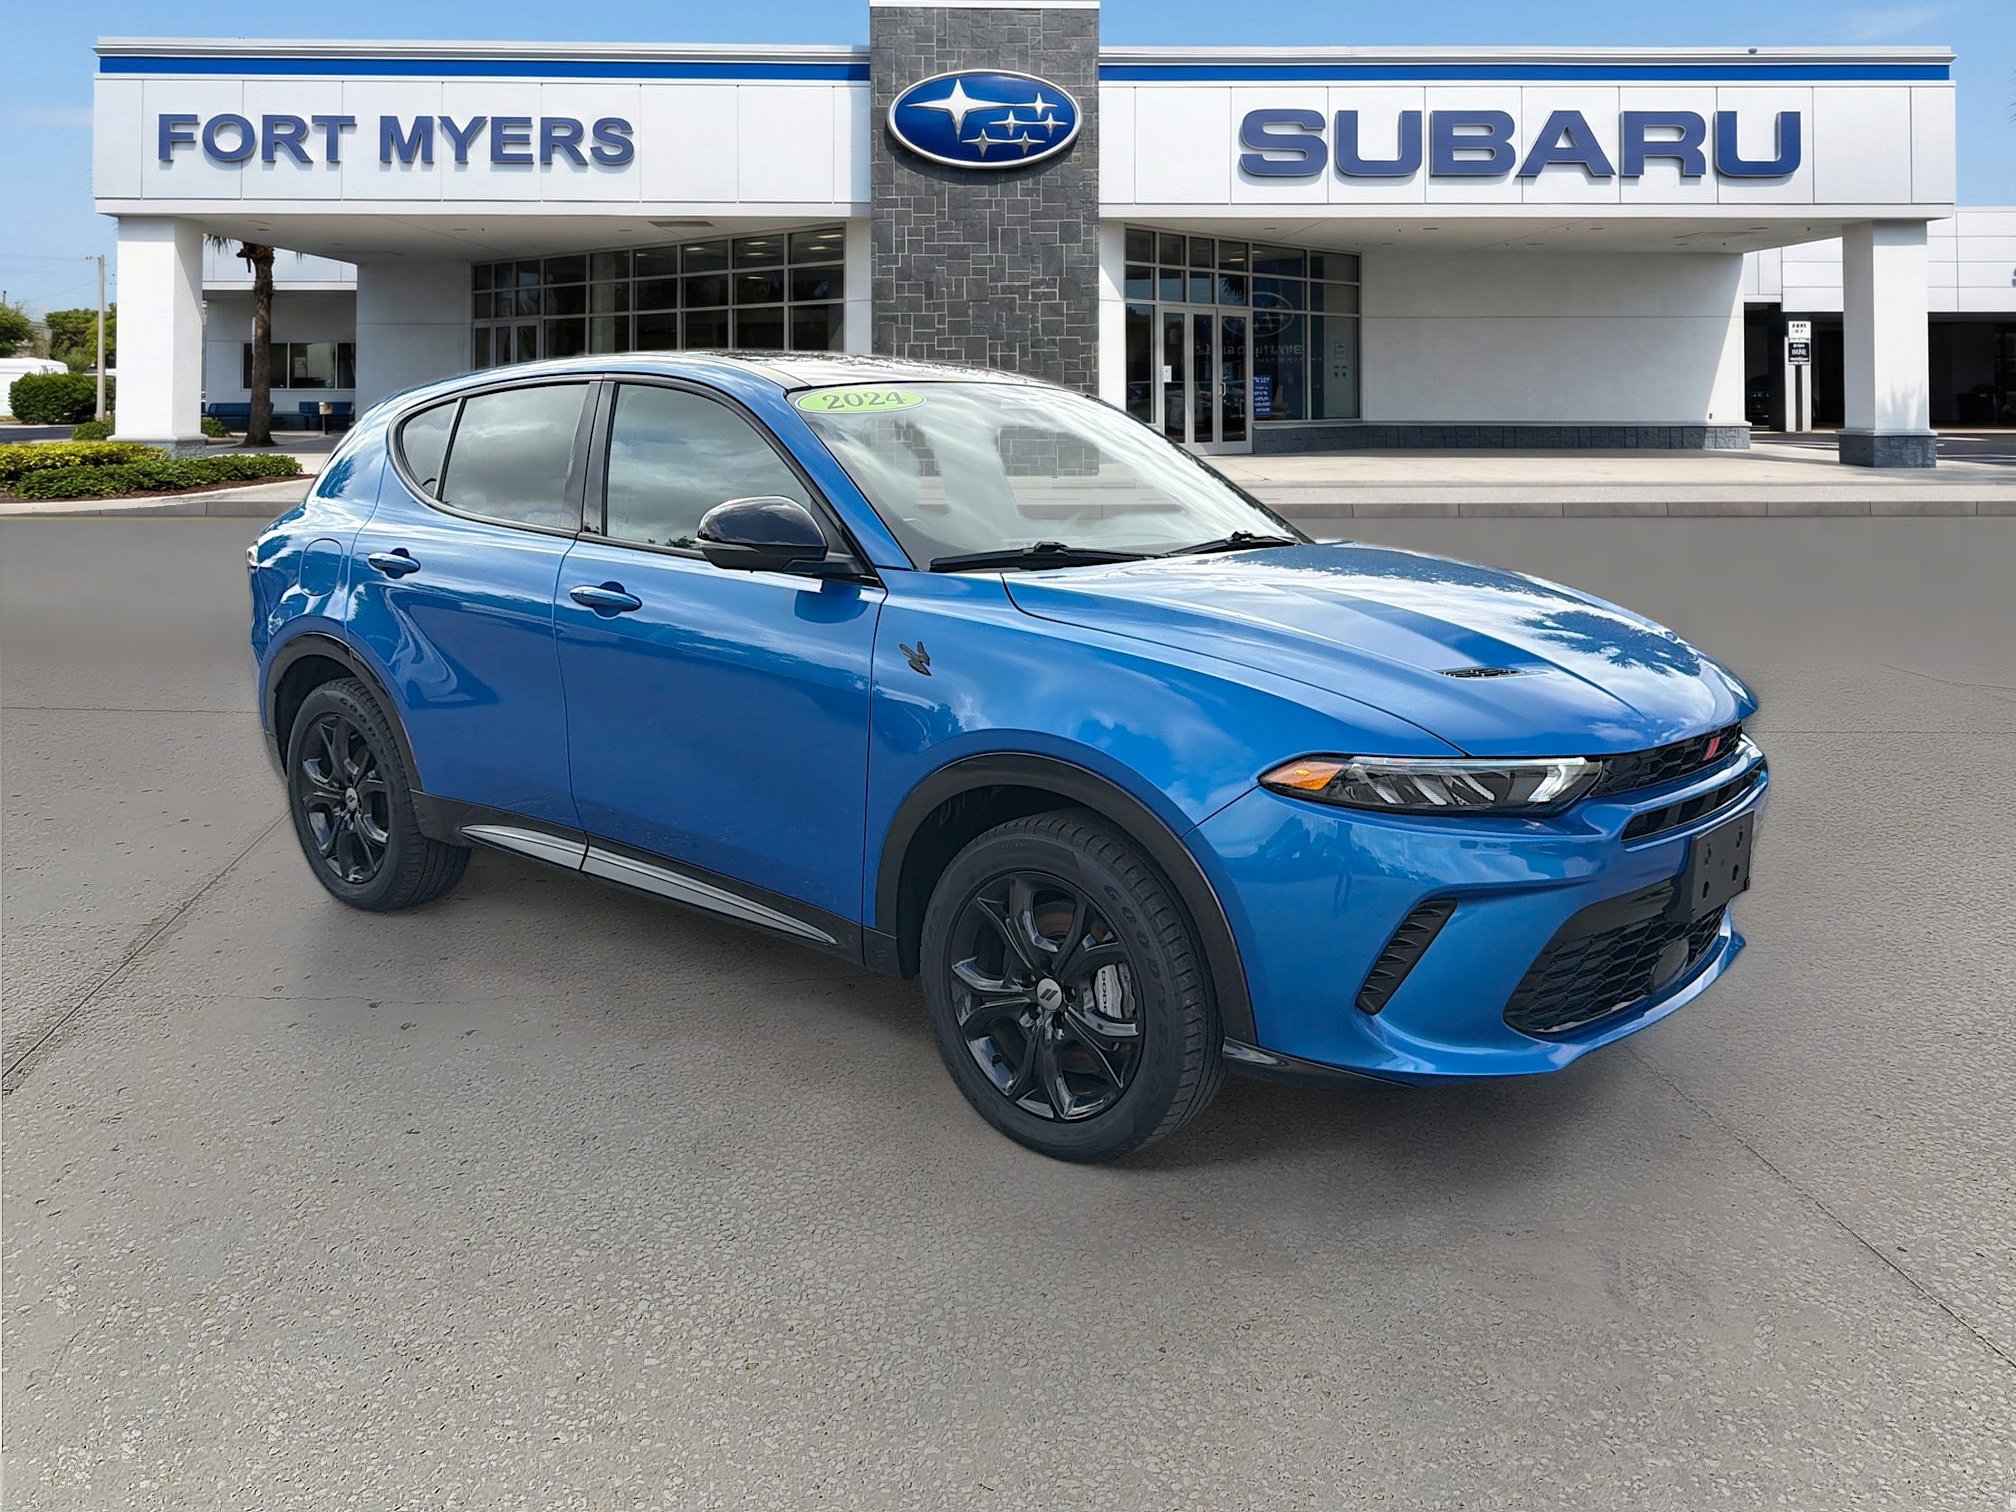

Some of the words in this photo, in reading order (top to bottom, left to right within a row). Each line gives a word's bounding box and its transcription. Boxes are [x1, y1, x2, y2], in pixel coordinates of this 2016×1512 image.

[157, 113, 357, 164] FORT
[379, 115, 636, 166] MYERS
[1239, 109, 1802, 178] SUBARU
[822, 391, 906, 410] 2024
